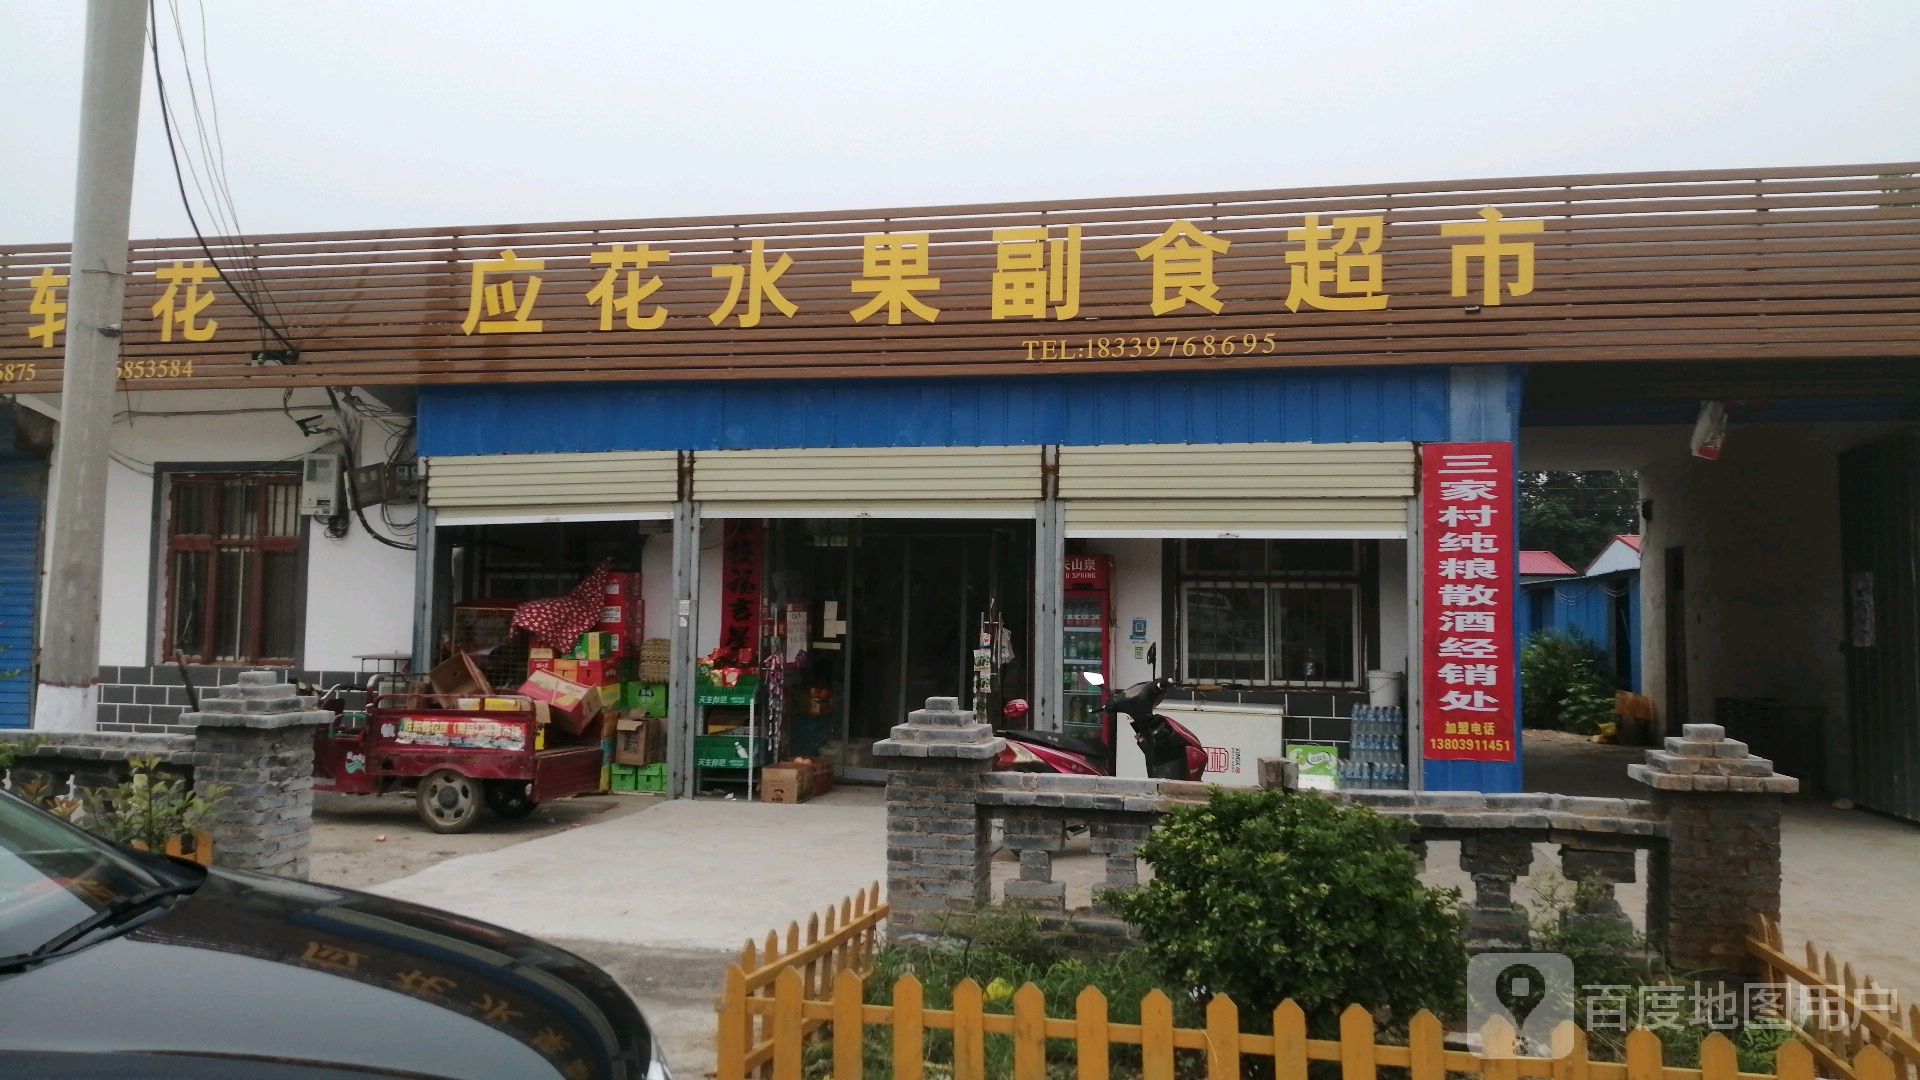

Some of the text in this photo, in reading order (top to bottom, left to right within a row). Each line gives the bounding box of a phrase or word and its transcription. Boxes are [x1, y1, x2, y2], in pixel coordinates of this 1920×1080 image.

[461, 205, 1545, 336] 应花水果副食超市
[1437, 454, 1500, 713] 三家村纯粮散酒经销处
[1430, 738, 1511, 752] 13803911451
[1444, 721, 1496, 736] 加盟电话
